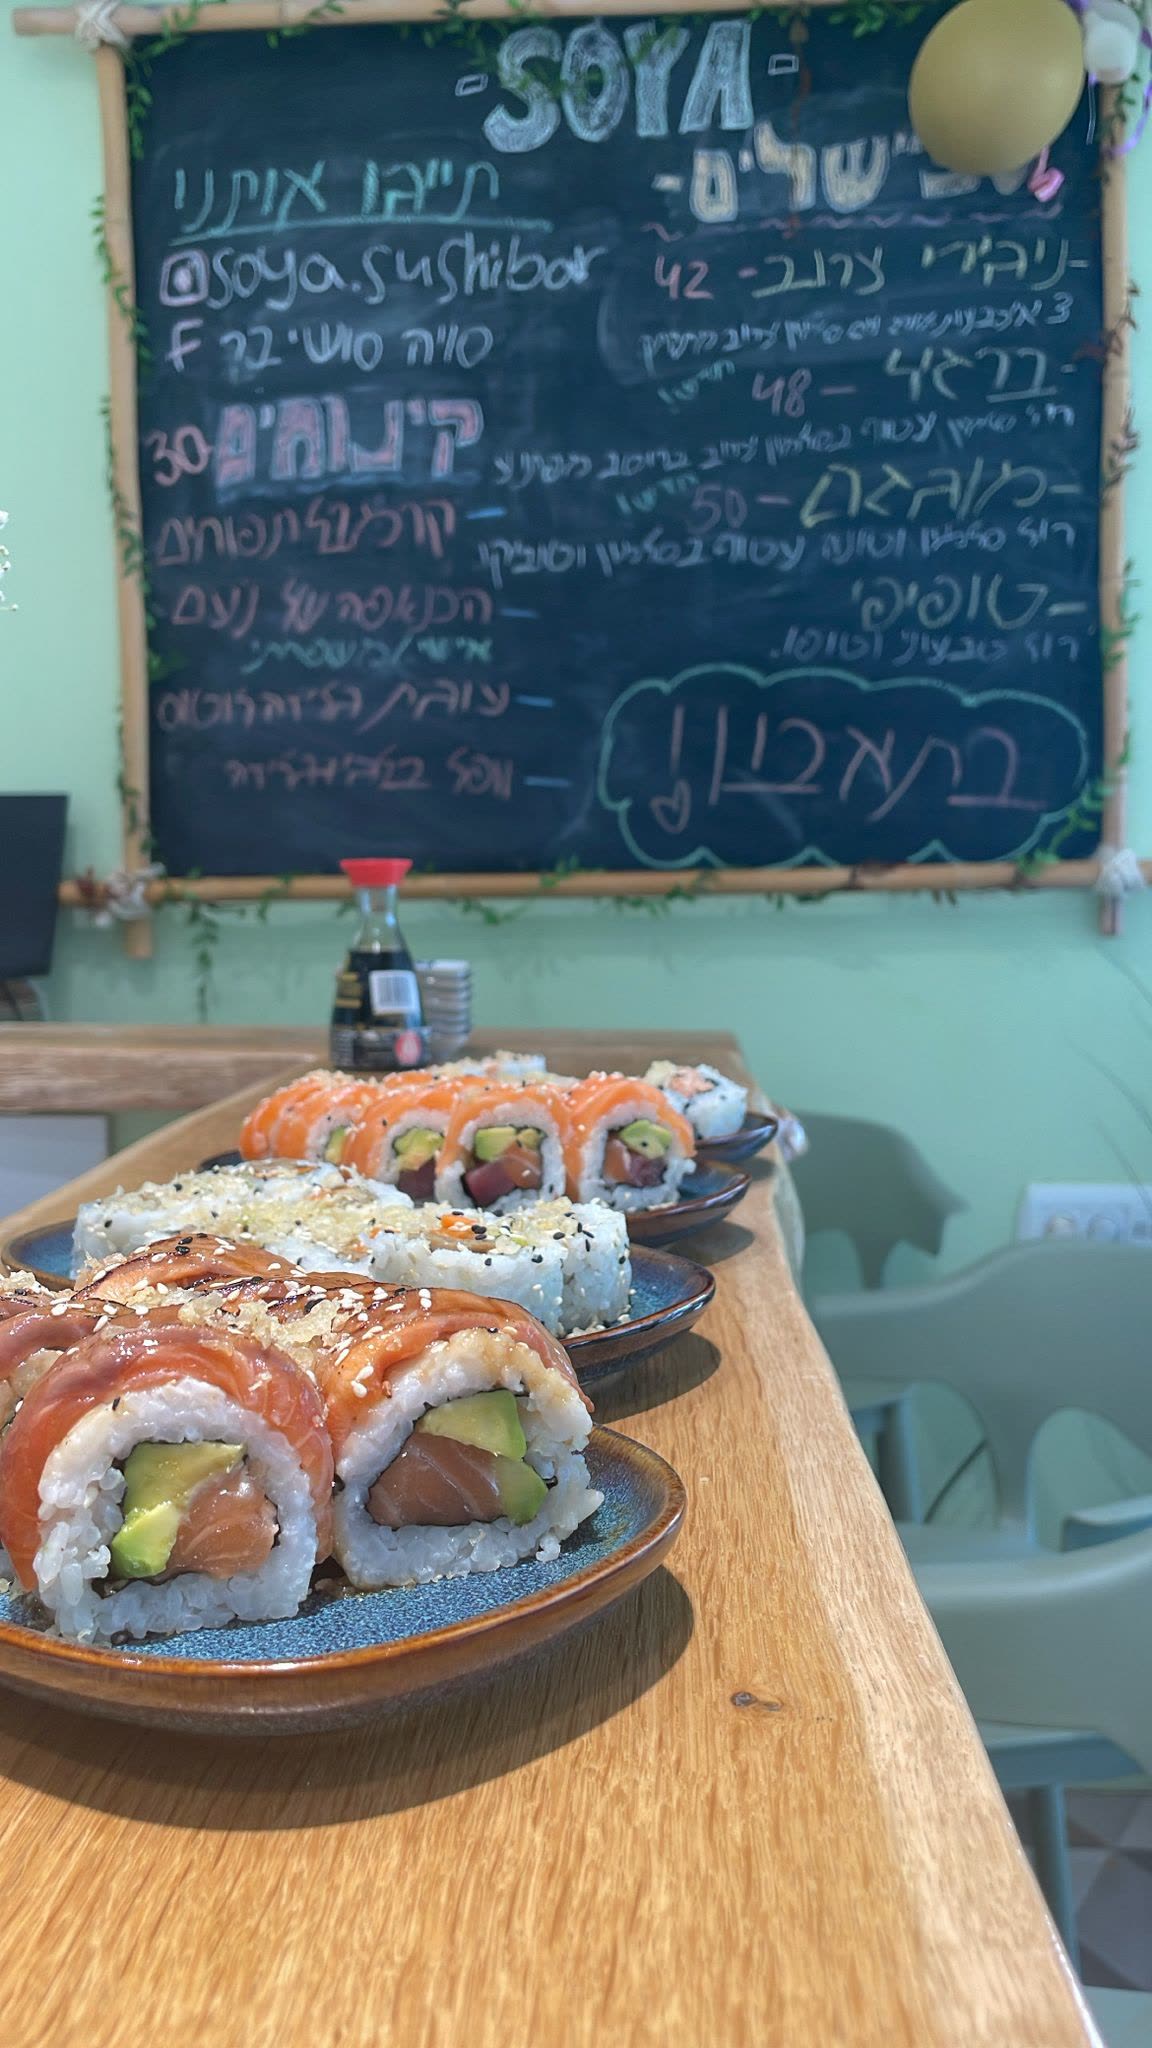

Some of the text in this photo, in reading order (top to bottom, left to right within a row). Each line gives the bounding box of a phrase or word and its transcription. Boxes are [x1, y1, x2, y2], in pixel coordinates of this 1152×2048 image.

[175, 160, 327, 234] אותנו
[655, 254, 714, 299] 42
[1045, 291, 1074, 325] 3
[402, 322, 494, 369] סויה
[752, 368, 812, 418] 48
